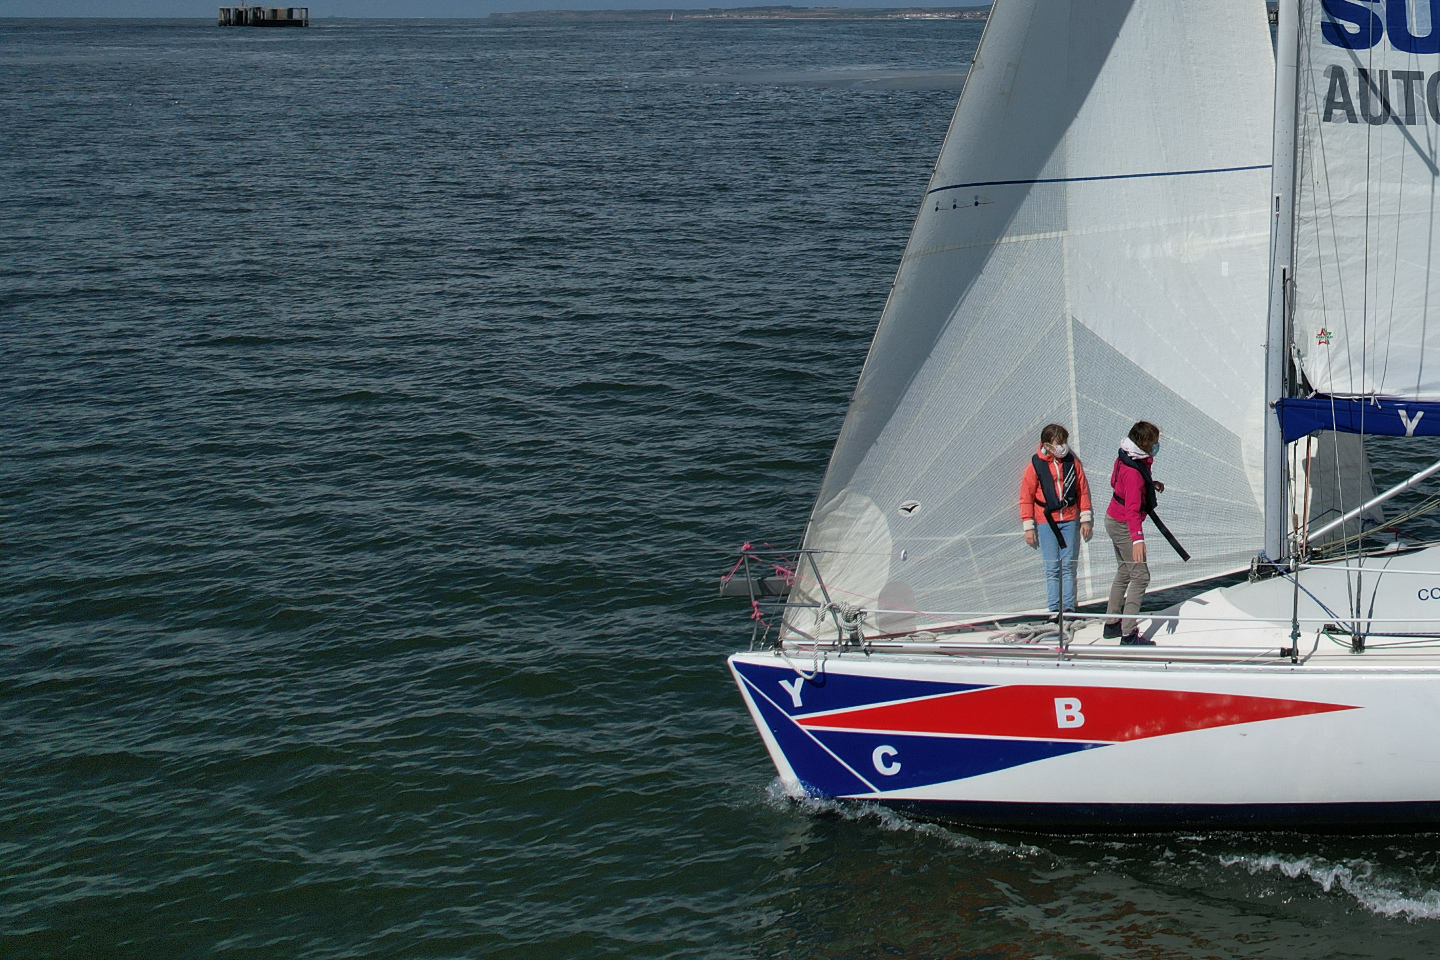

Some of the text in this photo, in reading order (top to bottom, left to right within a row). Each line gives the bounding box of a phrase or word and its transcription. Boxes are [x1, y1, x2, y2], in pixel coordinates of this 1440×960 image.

[778, 677, 805, 708] Y
[1054, 696, 1086, 729] B
[871, 745, 902, 776] C
